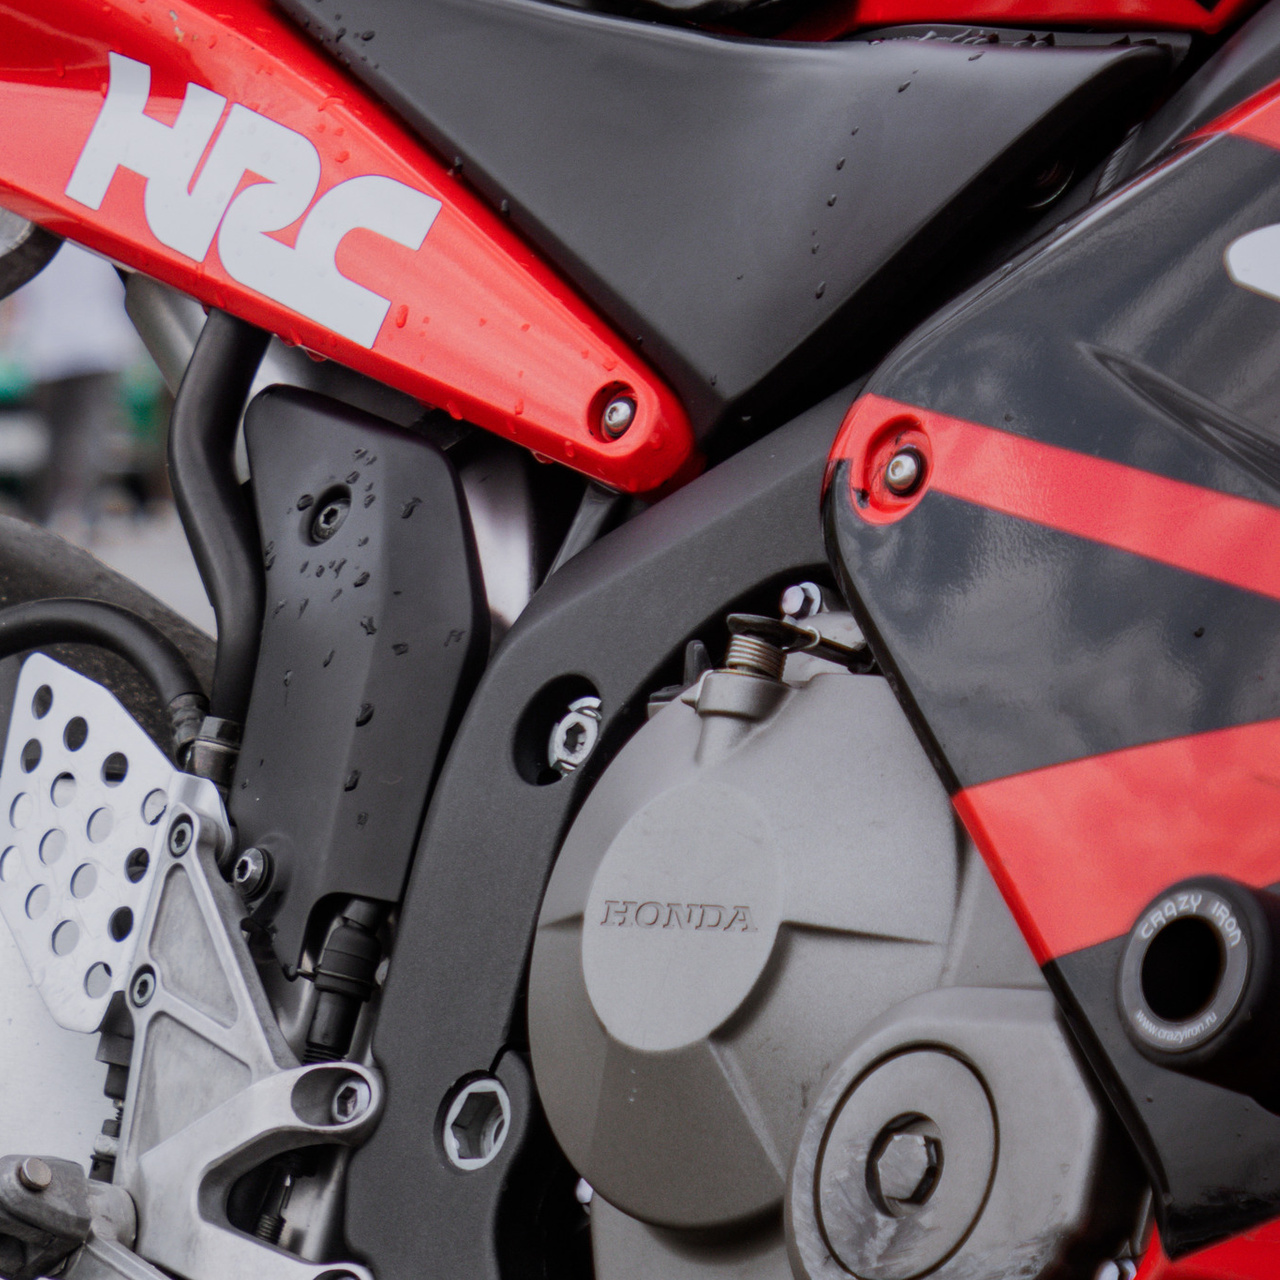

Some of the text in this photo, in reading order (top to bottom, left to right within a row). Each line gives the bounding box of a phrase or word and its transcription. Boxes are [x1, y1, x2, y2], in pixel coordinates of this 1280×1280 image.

[65, 51, 442, 349] HRC
[600, 899, 759, 932] HONDA
[1140, 893, 1203, 940] CRAZY
[1135, 1008, 1218, 1043] www.crazyiron.ru
